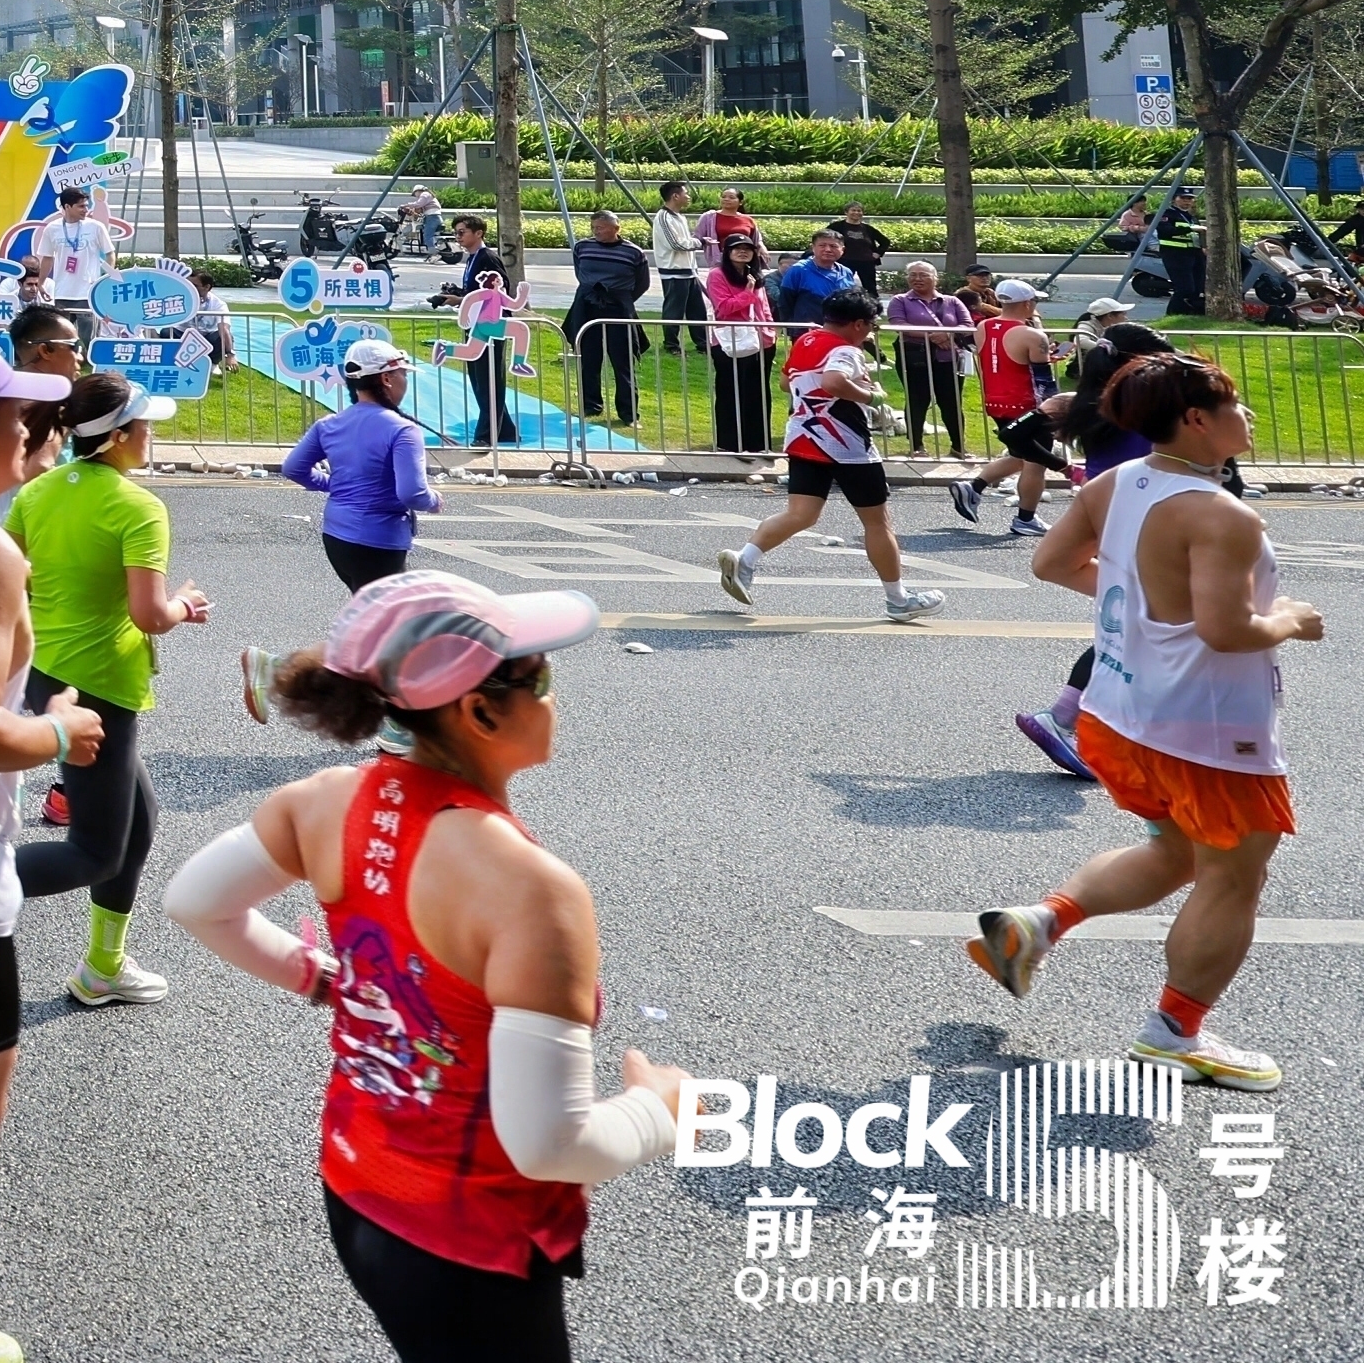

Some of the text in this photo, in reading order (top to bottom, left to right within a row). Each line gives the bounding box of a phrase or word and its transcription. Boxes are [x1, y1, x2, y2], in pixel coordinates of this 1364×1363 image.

[1146, 77, 1159, 92] P
[53, 162, 89, 177] LONGFOR
[57, 161, 132, 192] Run up
[112, 280, 156, 304] 汗水
[324, 279, 382, 298] 所畏惧
[143, 294, 186, 320] 变蓝
[113, 344, 163, 364] 梦想
